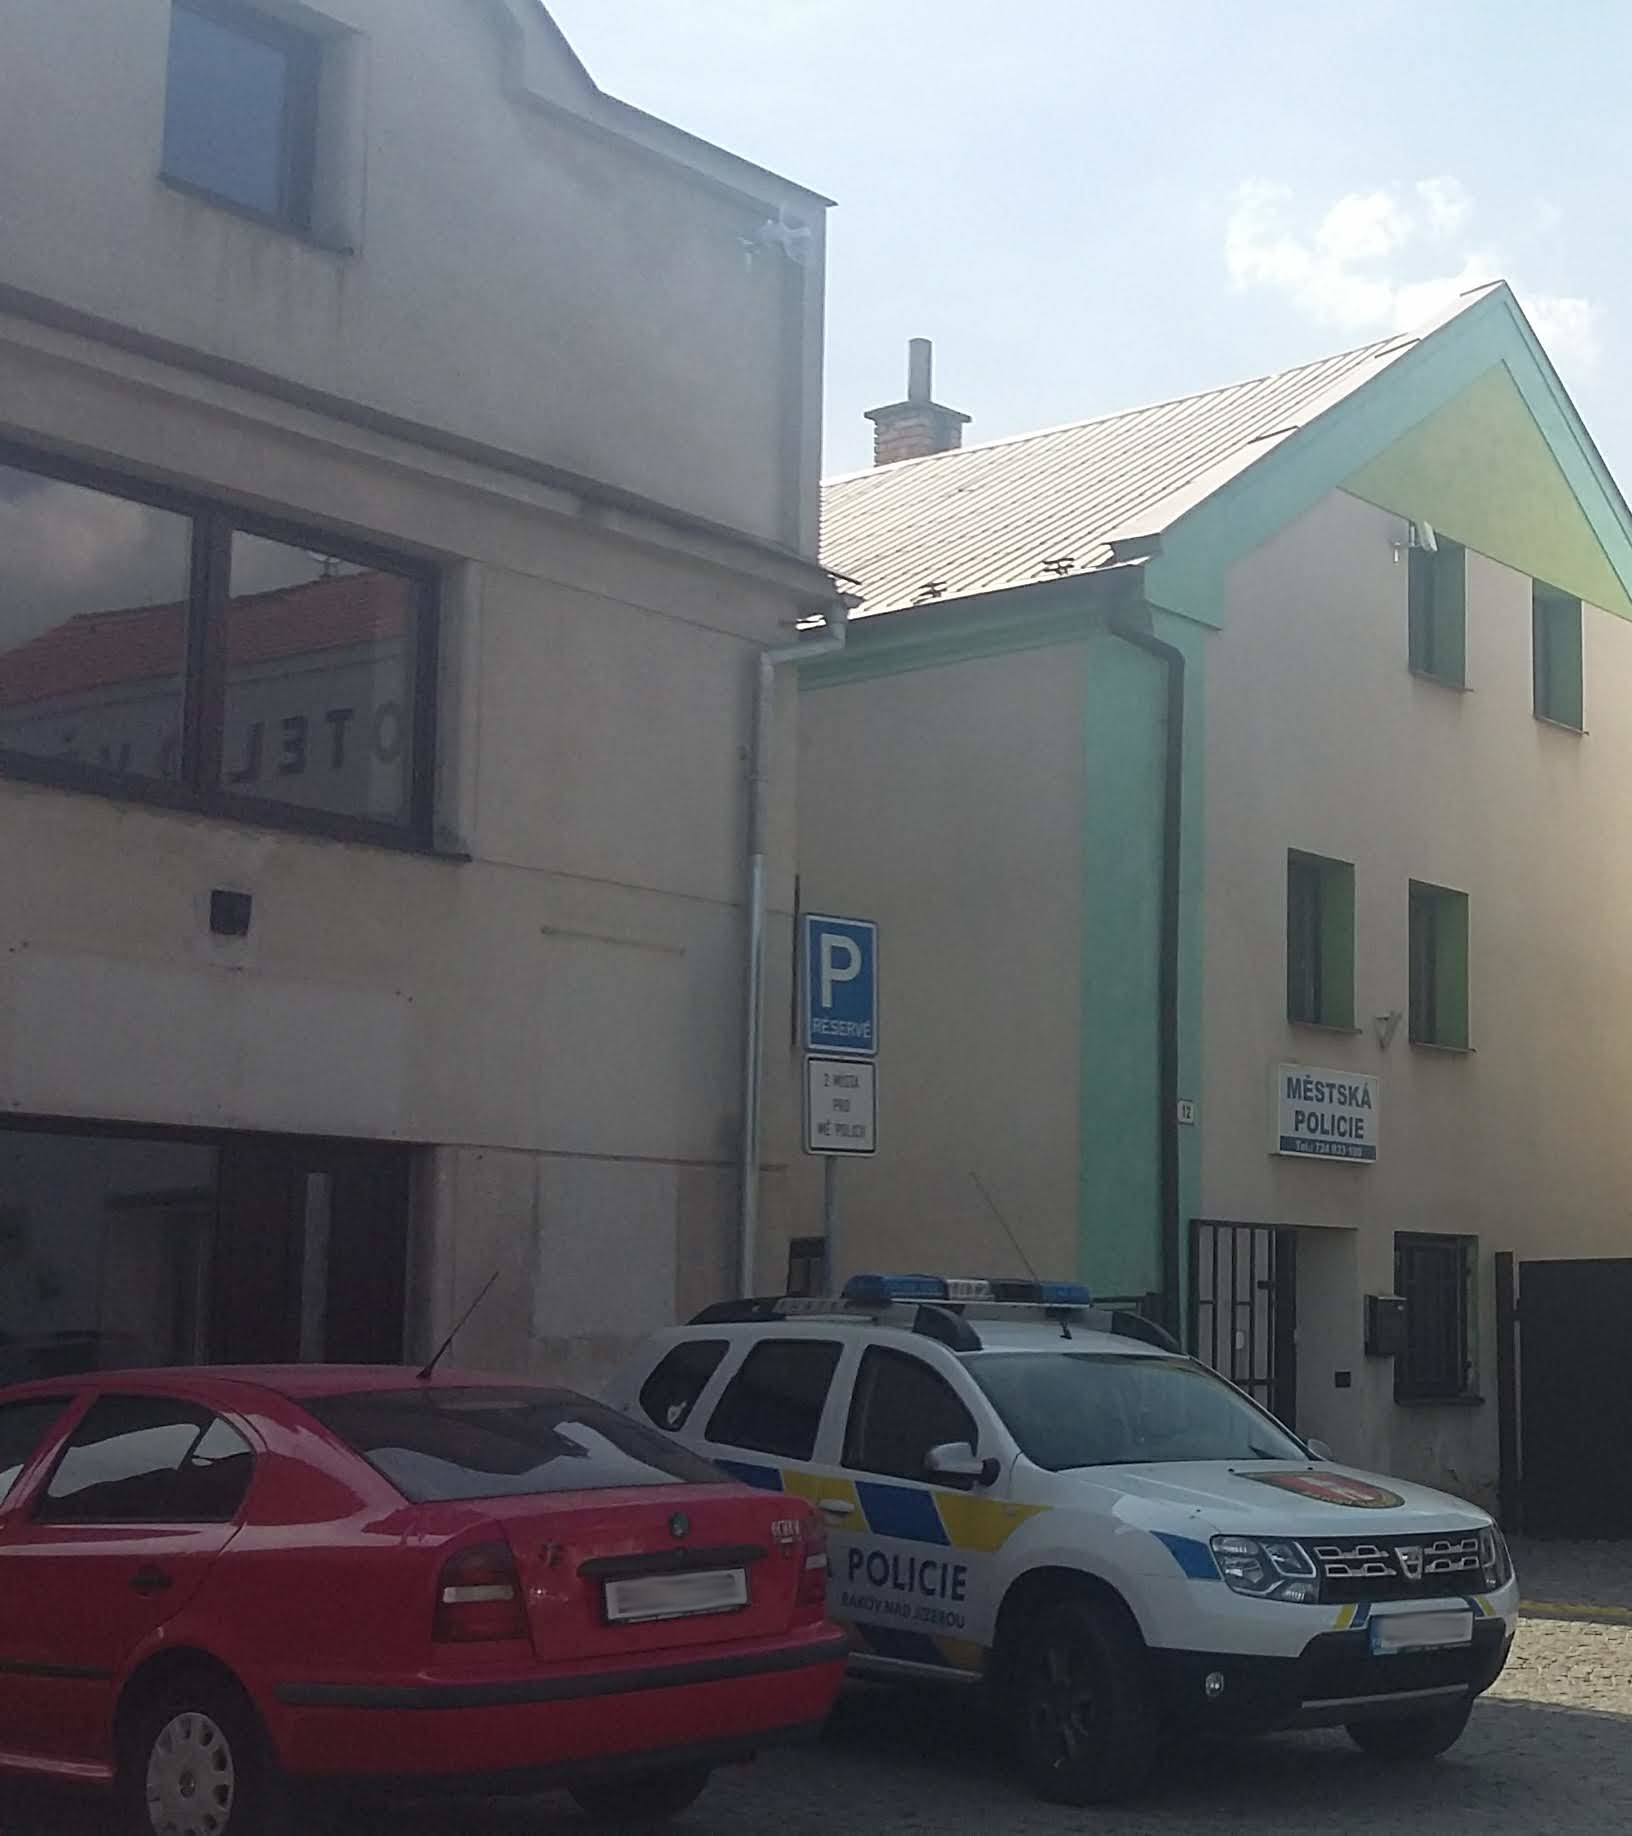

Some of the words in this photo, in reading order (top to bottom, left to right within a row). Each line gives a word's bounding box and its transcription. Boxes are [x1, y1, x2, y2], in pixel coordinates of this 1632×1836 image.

[821, 933, 862, 1008] P
[1287, 1074, 1372, 1110] MĚSTSKÁ
[1294, 1110, 1365, 1139] POLICIE
[848, 1547, 968, 1601] POLICIE
